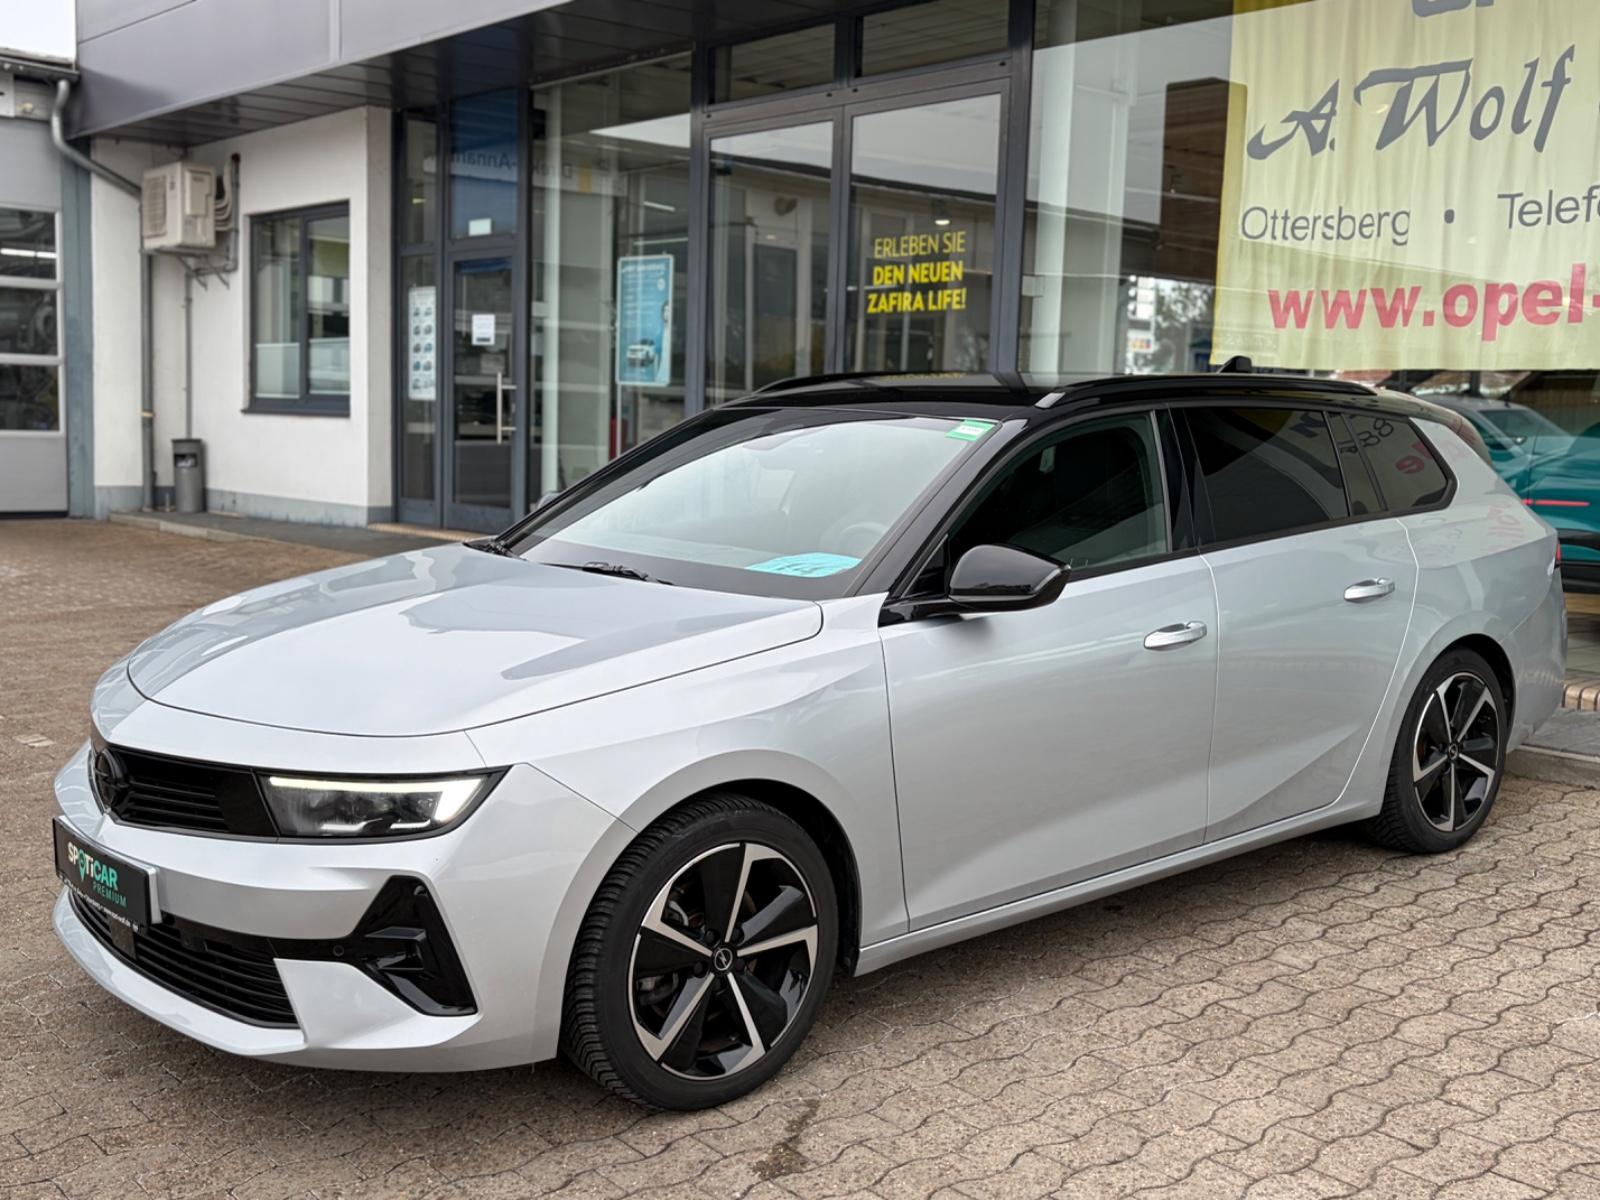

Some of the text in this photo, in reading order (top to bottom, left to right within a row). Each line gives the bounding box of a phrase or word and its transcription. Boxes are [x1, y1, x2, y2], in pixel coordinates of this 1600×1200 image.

[1354, 44, 1575, 152] Wolf
[1241, 185, 1600, 246] Ottersberg Telef
[874, 231, 966, 259] ERLEBEN SIE
[873, 261, 963, 287] DEN NEUEN
[867, 287, 967, 314] ZAFIRA LIFE!
[92, 881, 127, 908] PREMIUM
